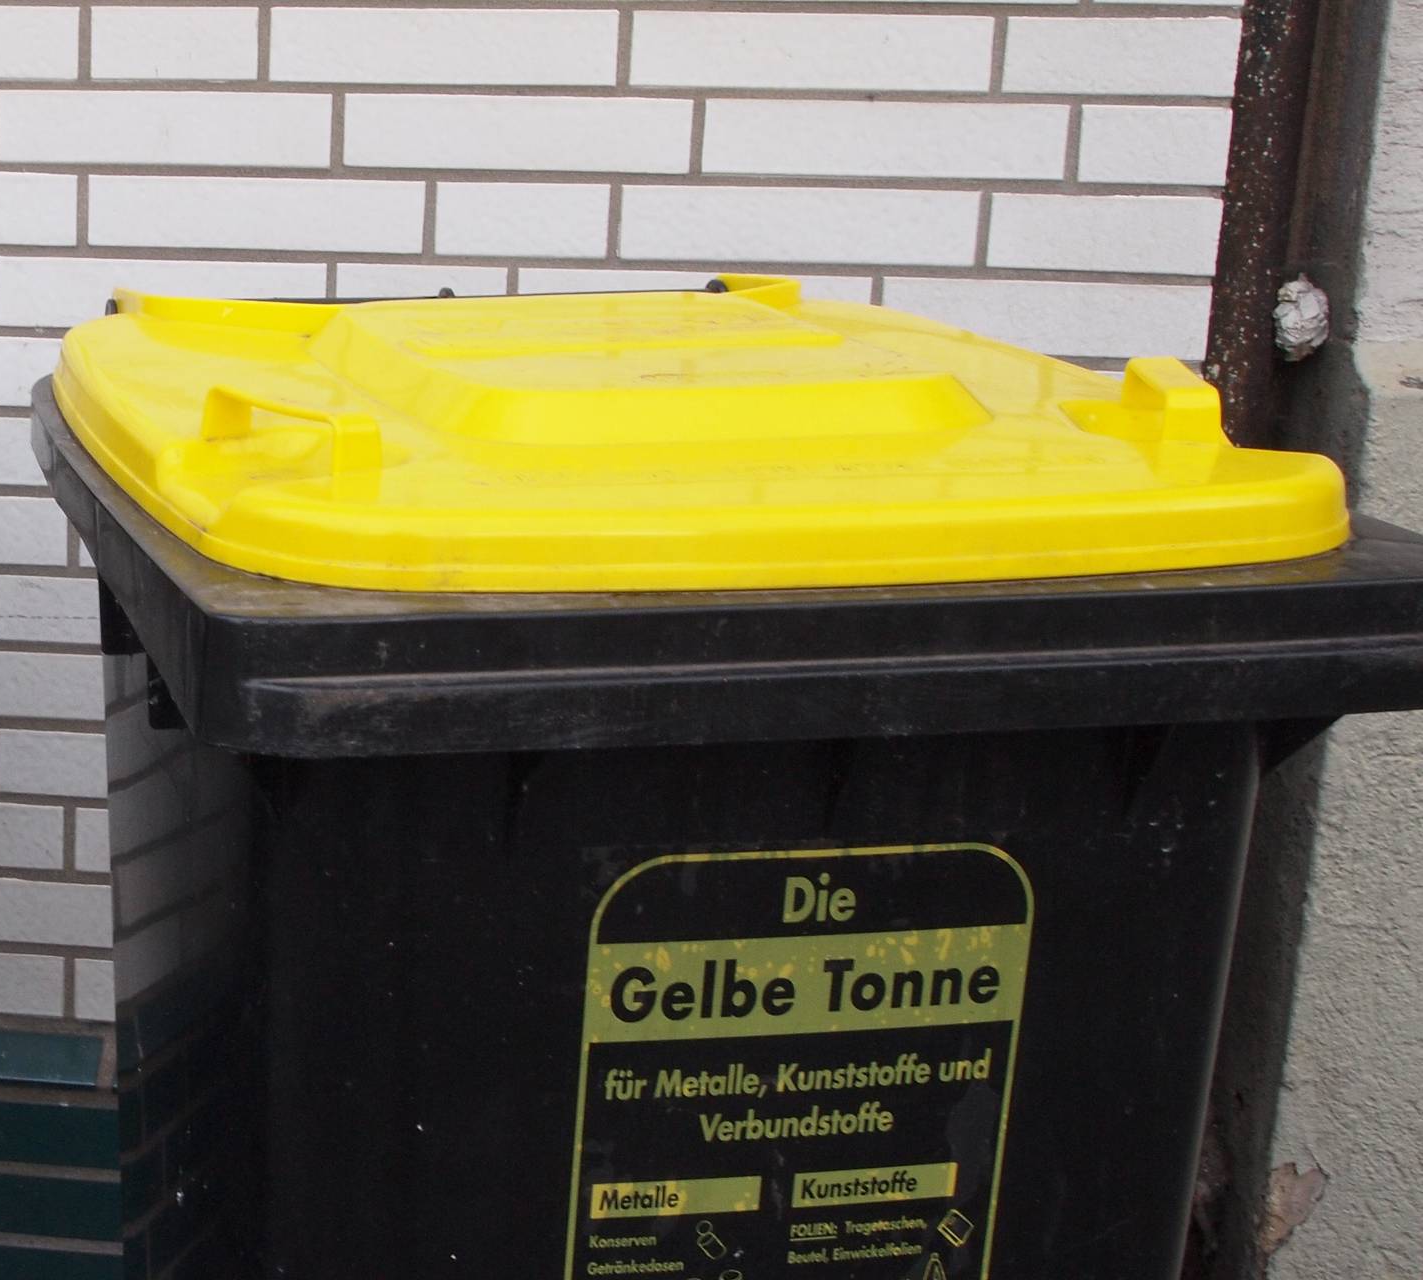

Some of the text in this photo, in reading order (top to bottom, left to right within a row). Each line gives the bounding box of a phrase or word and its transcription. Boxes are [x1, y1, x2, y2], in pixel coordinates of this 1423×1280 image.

[782, 872, 856, 923] Die
[610, 958, 1001, 1023] Gelbe Tonne
[604, 1049, 992, 1100] für Metalle, Kunststoffe und
[699, 1102, 894, 1142] Verbundstoffe
[599, 1185, 680, 1211] Metalle
[800, 1170, 918, 1200] Kunststoffe
[588, 1235, 657, 1249] Konserven
[790, 1222, 838, 1241] FOLIEN:
[833, 1241, 923, 1262] Einwickelfolien
[587, 1258, 685, 1276] Getränkedosen
